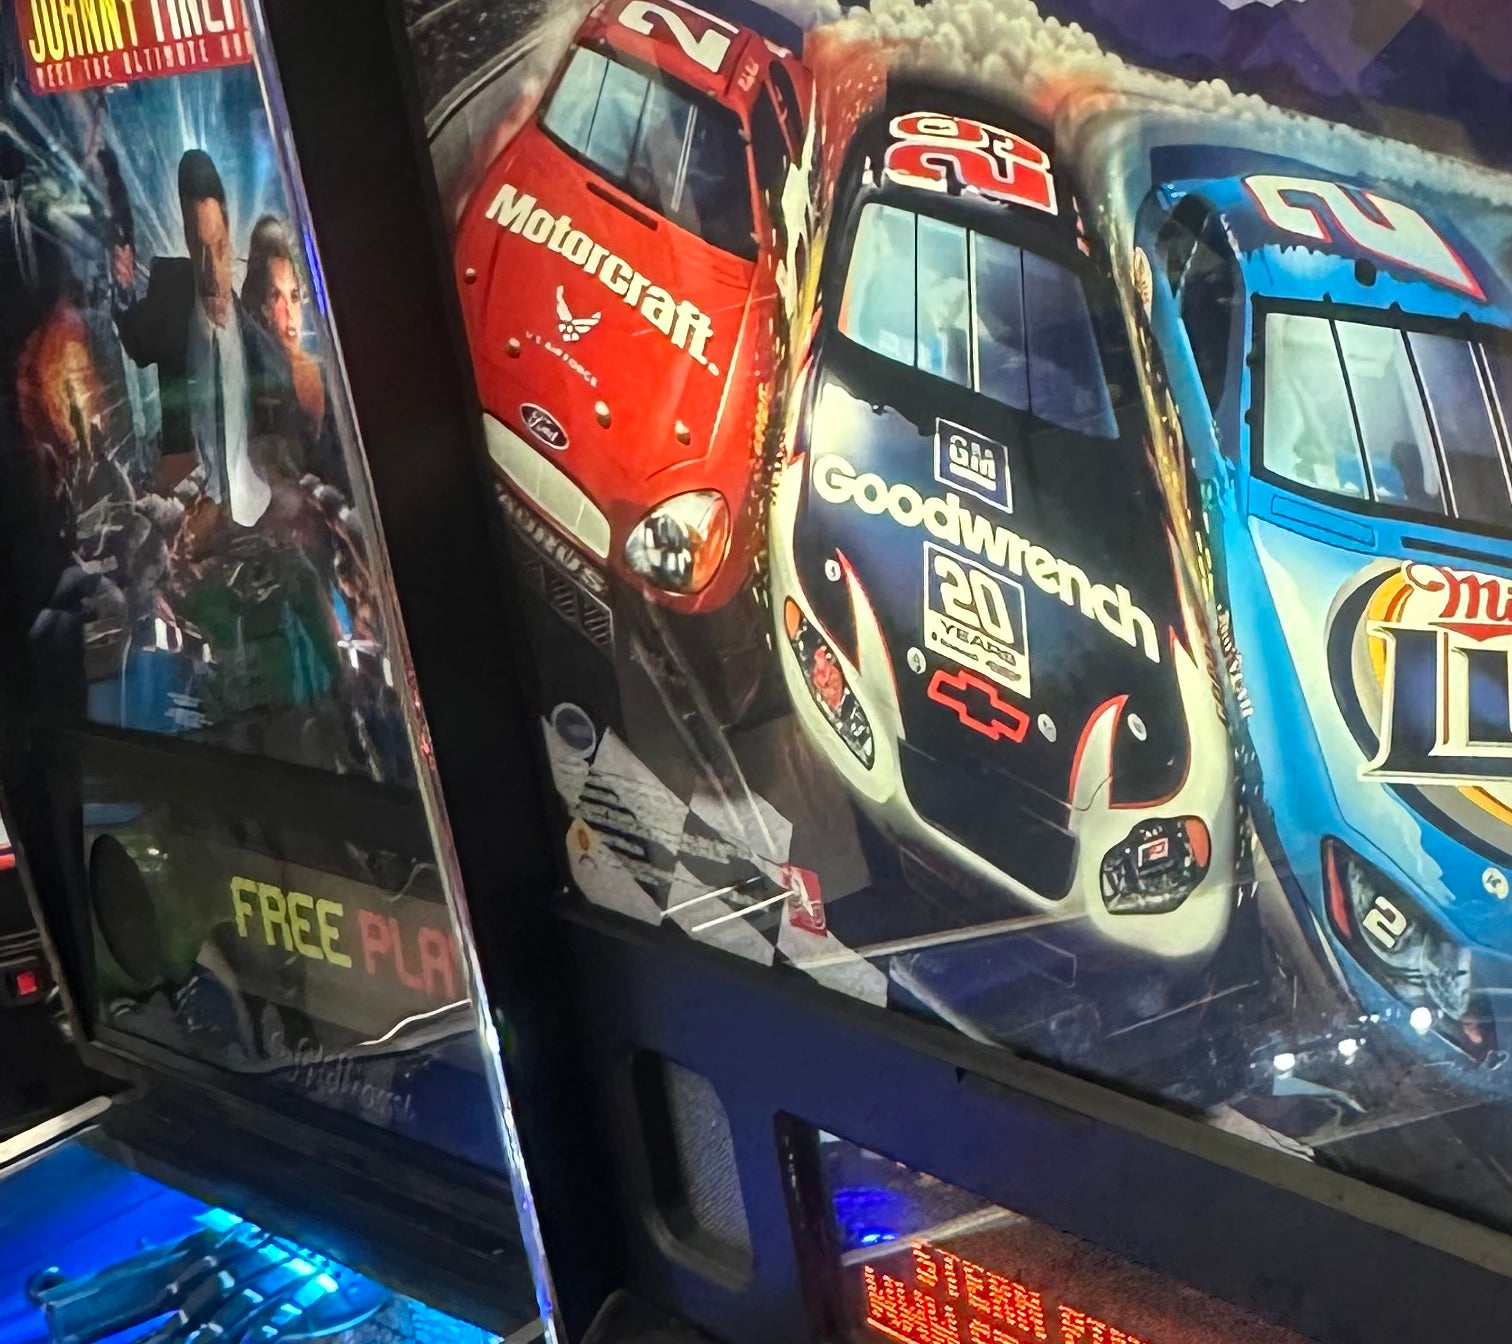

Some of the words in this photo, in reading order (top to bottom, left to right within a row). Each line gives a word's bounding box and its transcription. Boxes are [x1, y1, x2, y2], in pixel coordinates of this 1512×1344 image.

[1241, 174, 1487, 303] 2
[813, 454, 1160, 664] Goodwrench
[934, 555, 1015, 645] 20
[230, 876, 352, 968] FREE
[1362, 896, 1408, 949] 2
[911, 1238, 1048, 1341] STERN
